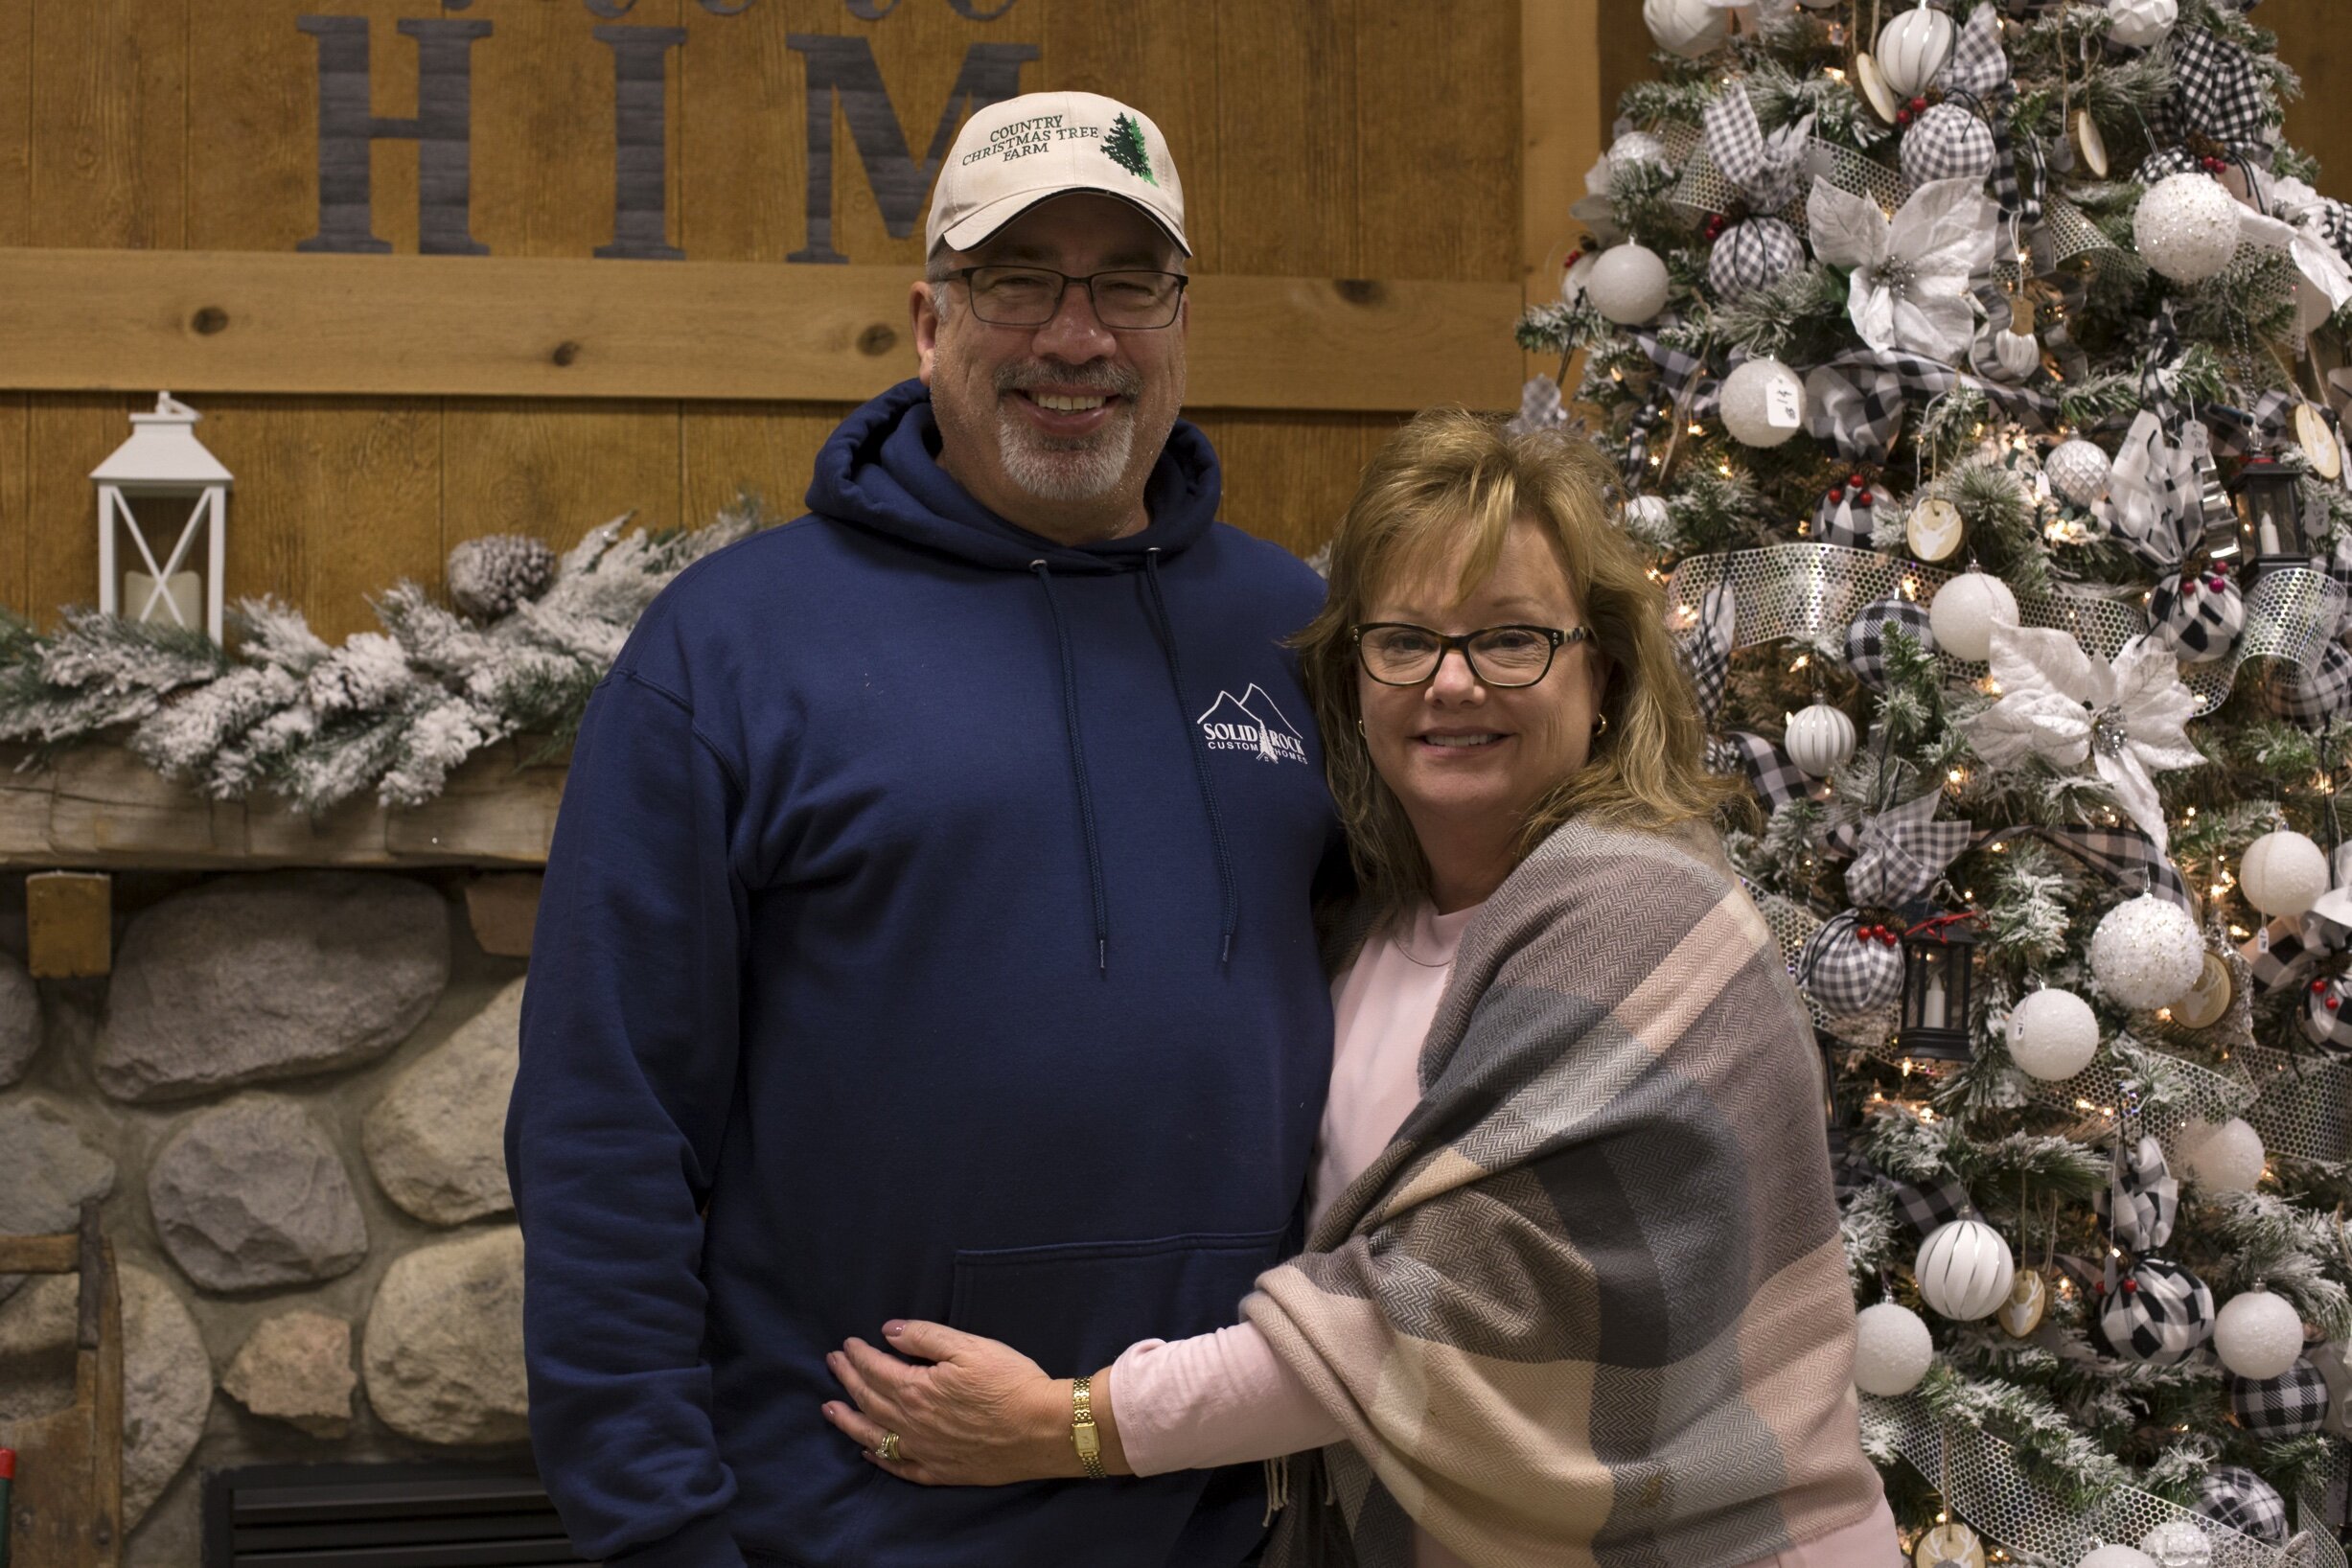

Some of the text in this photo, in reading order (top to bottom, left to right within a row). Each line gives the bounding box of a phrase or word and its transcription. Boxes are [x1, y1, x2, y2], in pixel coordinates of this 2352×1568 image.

[296, 15, 1041, 265] HIM
[990, 115, 1063, 143] COUNTRY
[962, 127, 1099, 166] CHRISTMAS TREE
[1003, 143, 1049, 163] FARM
[1203, 723, 1304, 755] SOLID ROCK
[1208, 741, 1308, 765] CUSTOM HOMES
